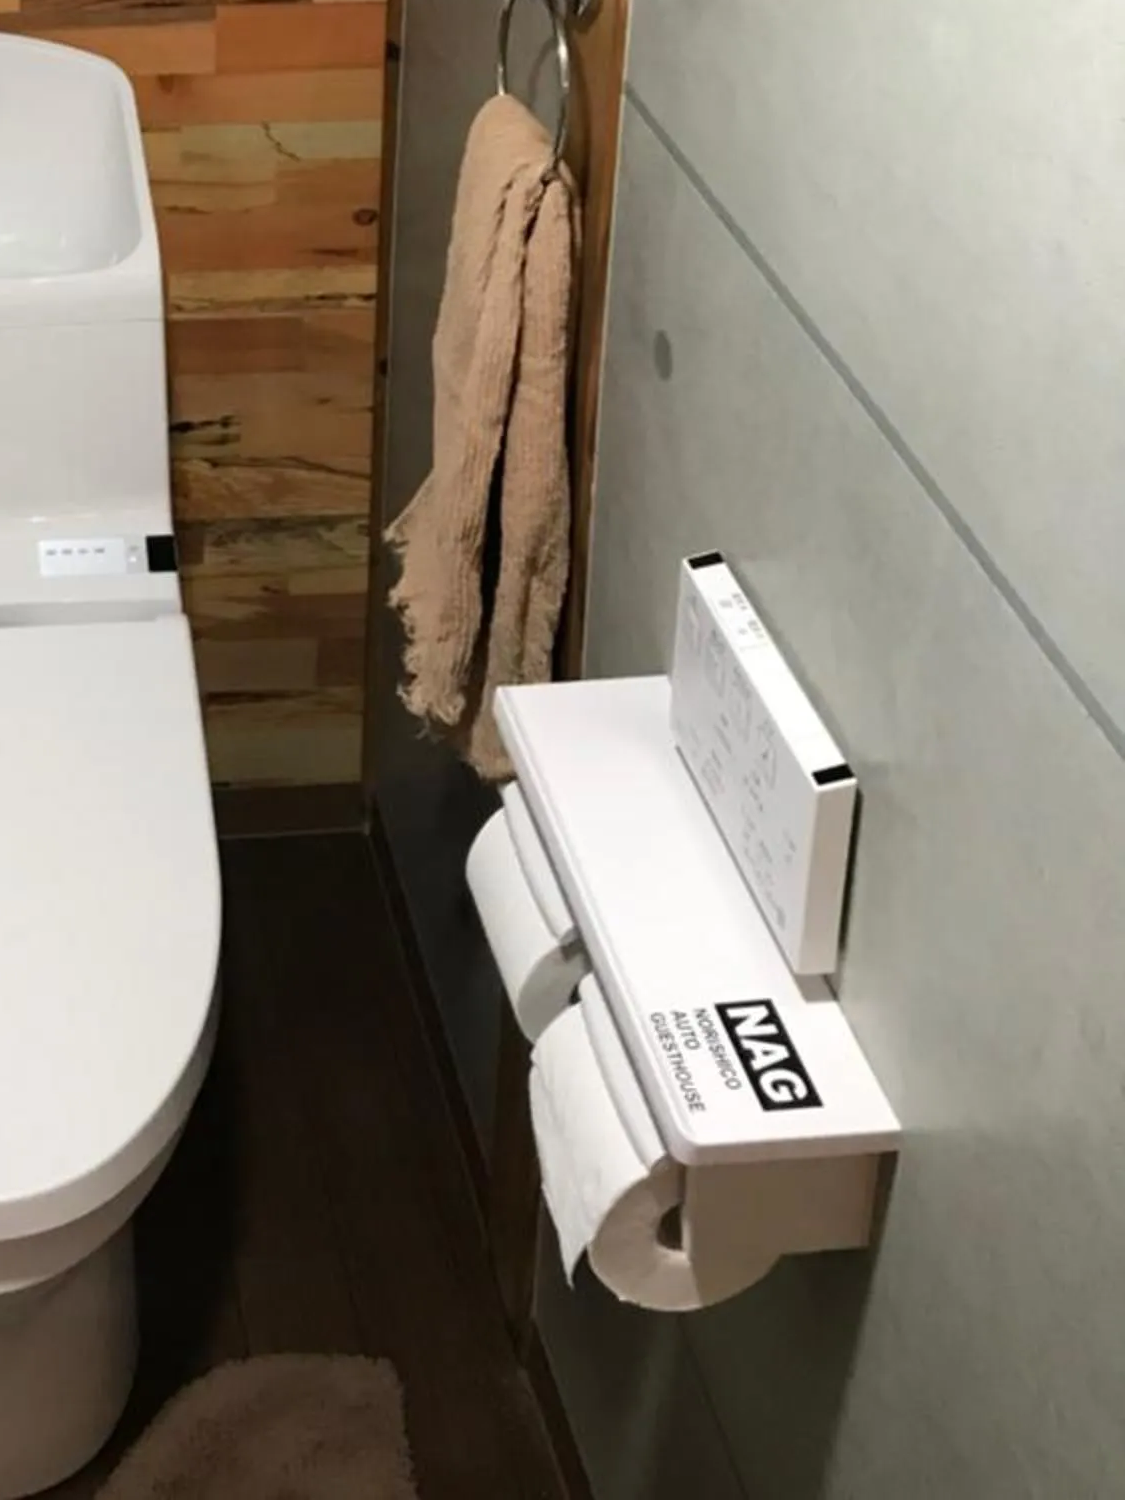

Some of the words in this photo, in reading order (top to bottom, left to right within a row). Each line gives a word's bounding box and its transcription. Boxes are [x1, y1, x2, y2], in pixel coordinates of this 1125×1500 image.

[649, 1012, 706, 1113] GUESTHOUSE
[671, 1010, 700, 1051] AUTO
[693, 1007, 742, 1091] NORISHICO
[725, 1005, 808, 1104] NAG
